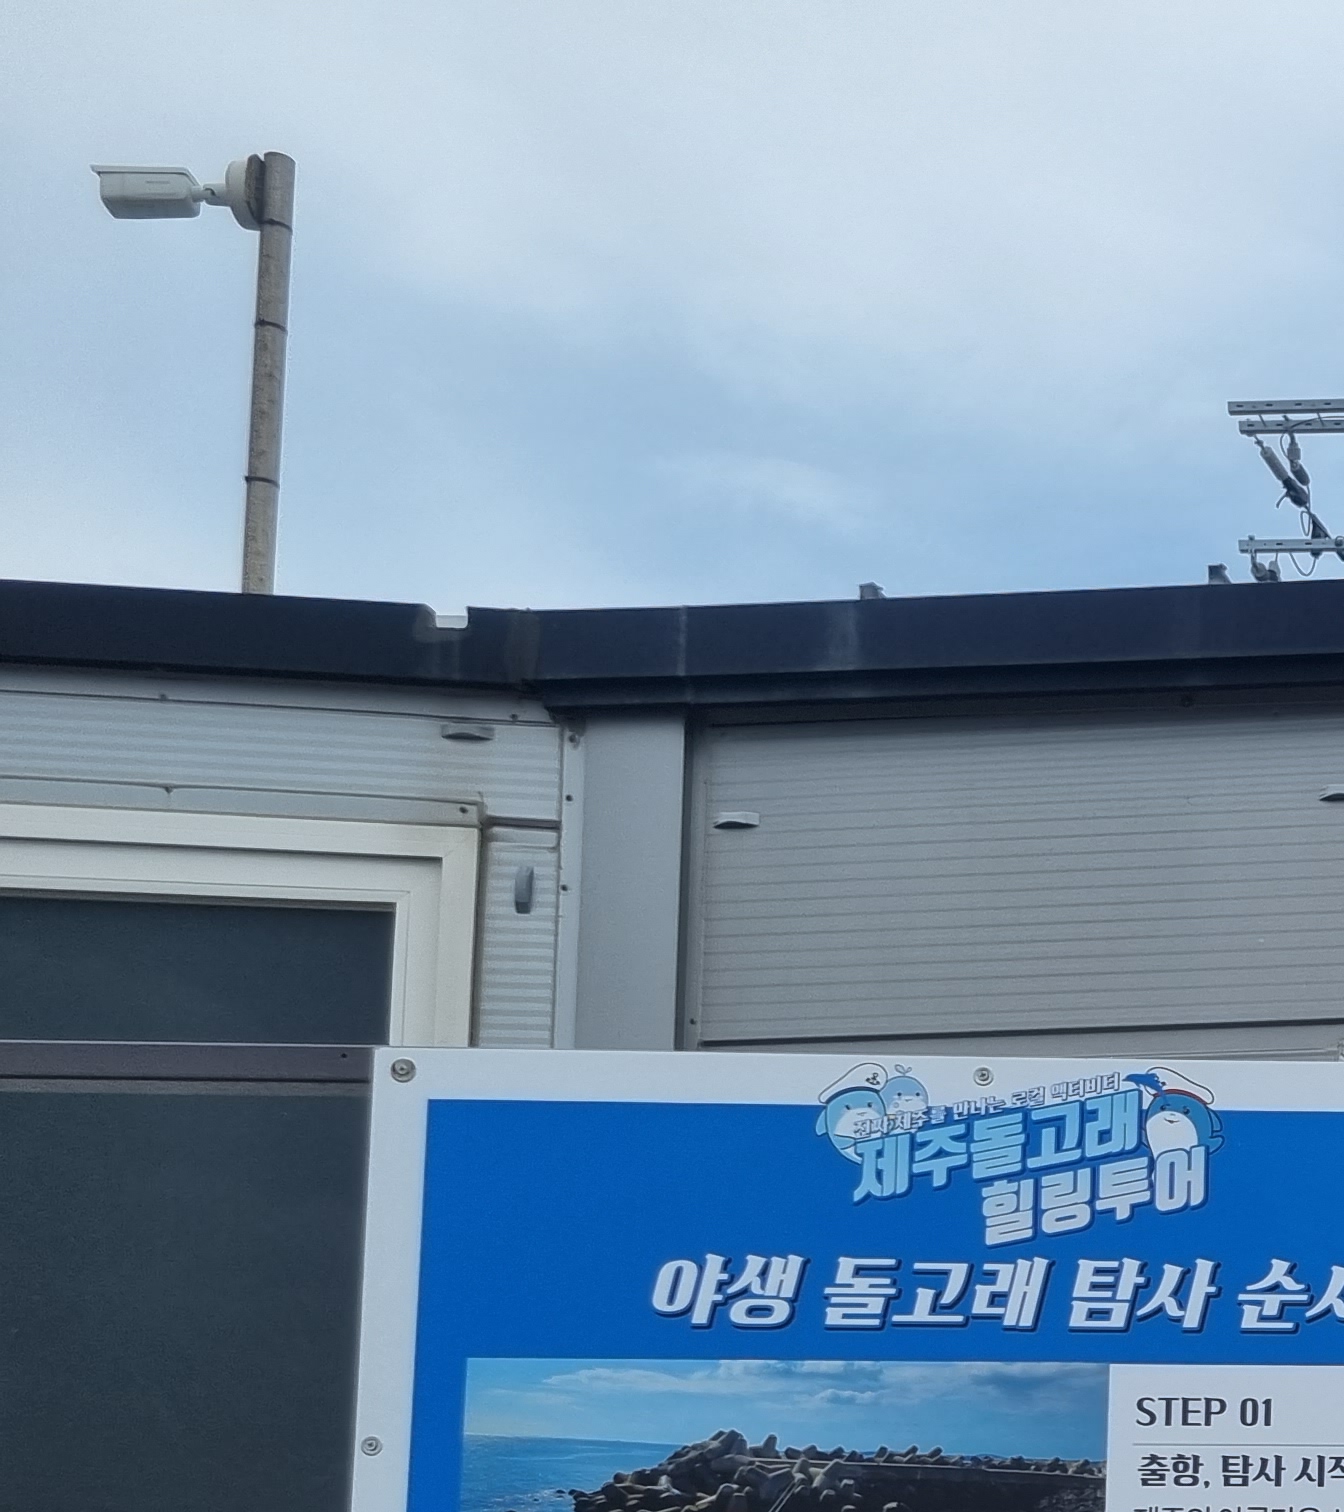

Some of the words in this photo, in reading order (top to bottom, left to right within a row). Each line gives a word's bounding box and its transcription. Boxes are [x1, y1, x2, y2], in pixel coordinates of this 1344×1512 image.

[953, 1097, 1006, 1120] 만나는
[1010, 1086, 1045, 1108] 로컬
[853, 1089, 1143, 1202] 제주돌고래
[983, 1143, 1208, 1246] 힐링투어
[651, 1252, 807, 1328] 야생
[823, 1256, 1052, 1331] 돌고래
[1068, 1256, 1219, 1333] 탐사
[1135, 1396, 1227, 1428] STEP
[1239, 1397, 1274, 1428] 01
[1137, 1453, 1211, 1489] 출항,
[1222, 1454, 1287, 1488] 탐사
